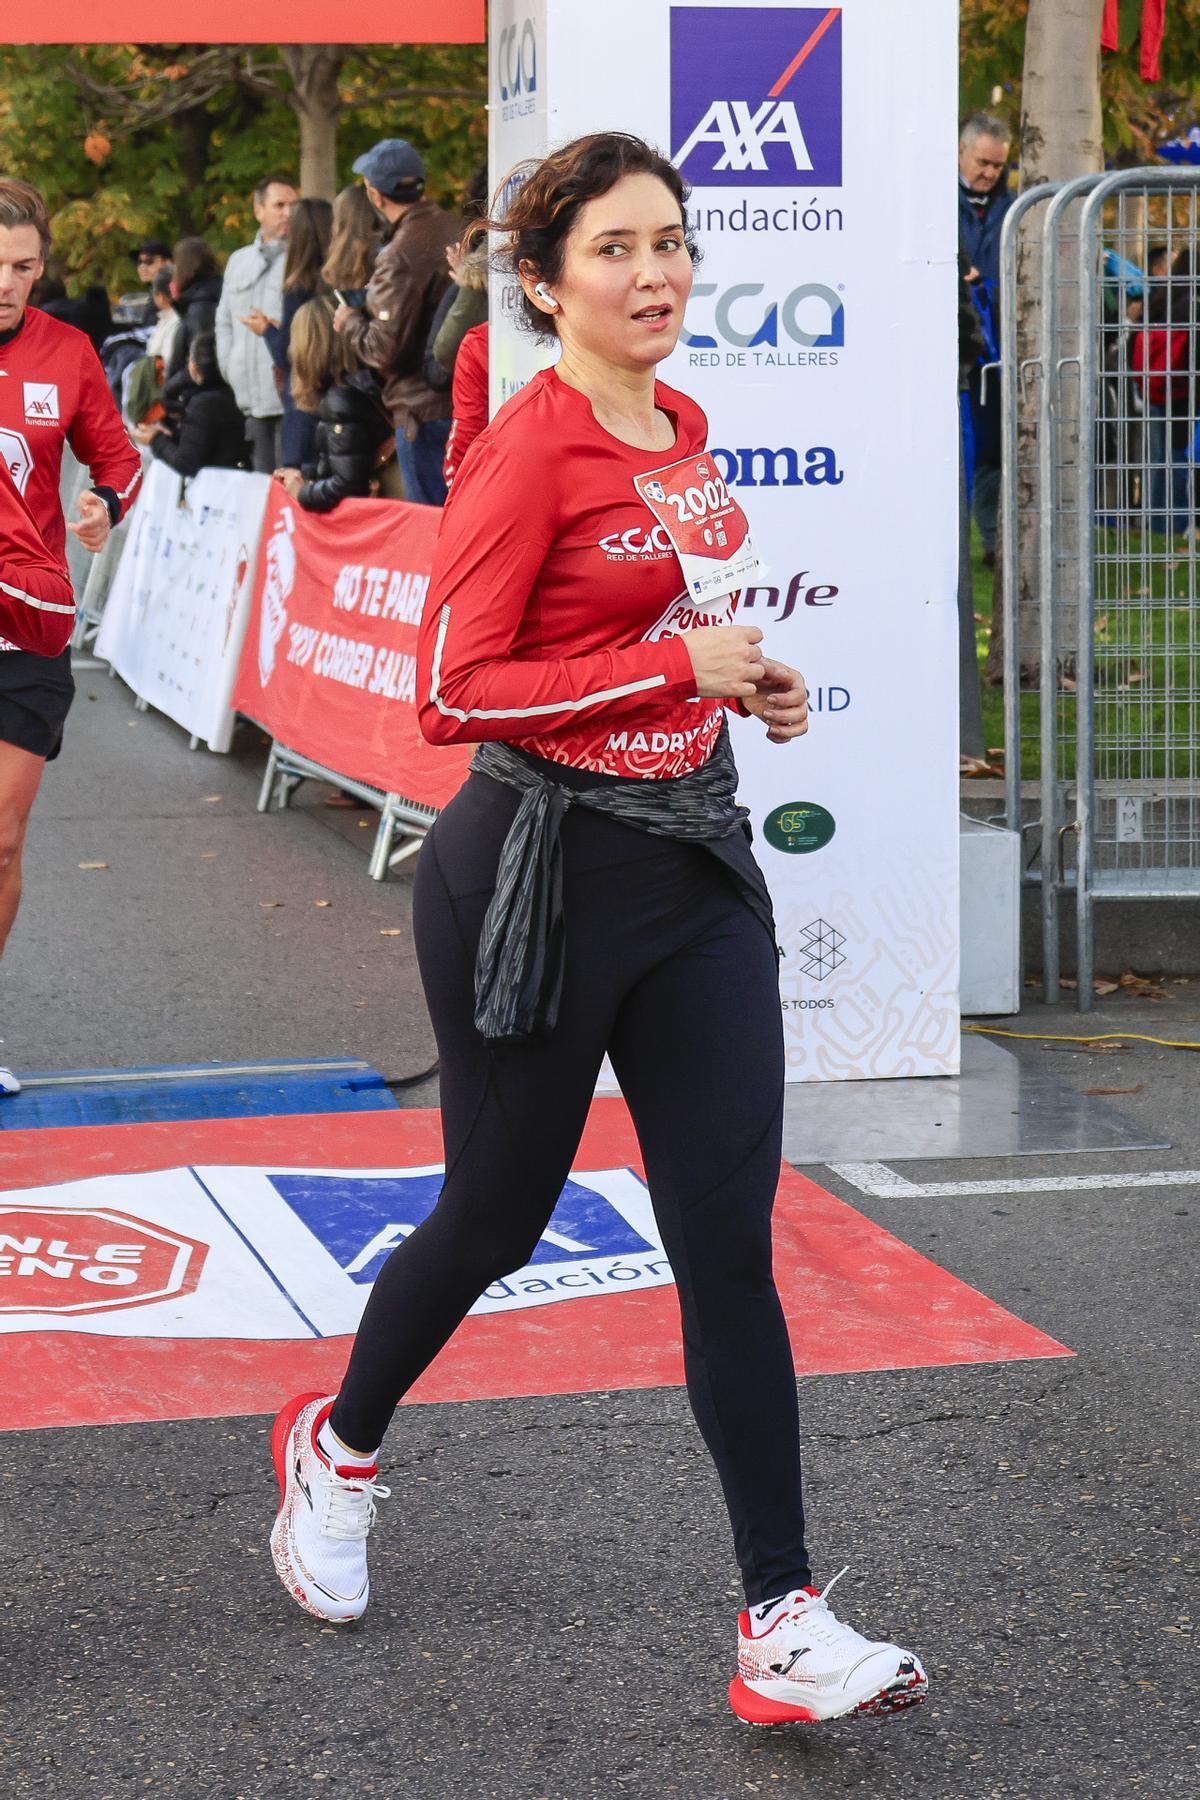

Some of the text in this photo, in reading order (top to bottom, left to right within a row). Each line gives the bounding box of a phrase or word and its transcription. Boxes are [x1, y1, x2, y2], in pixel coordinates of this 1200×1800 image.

[672, 101, 815, 171] AXA
[694, 197, 843, 232] undación
[689, 352, 839, 366] RED DE TALLERES
[25, 418, 61, 427] fundación
[27, 400, 54, 416] AXA
[711, 447, 844, 486] oma
[667, 477, 731, 523] 2002
[640, 552, 673, 561] TALLERES
[333, 565, 363, 612] NO
[360, 567, 389, 617] TE
[744, 571, 839, 623] nfe
[313, 632, 375, 689] CORRER
[791, 999, 835, 1009] TODOS
[0, 1234, 147, 1264] NLE
[483, 1259, 672, 1300] dación
